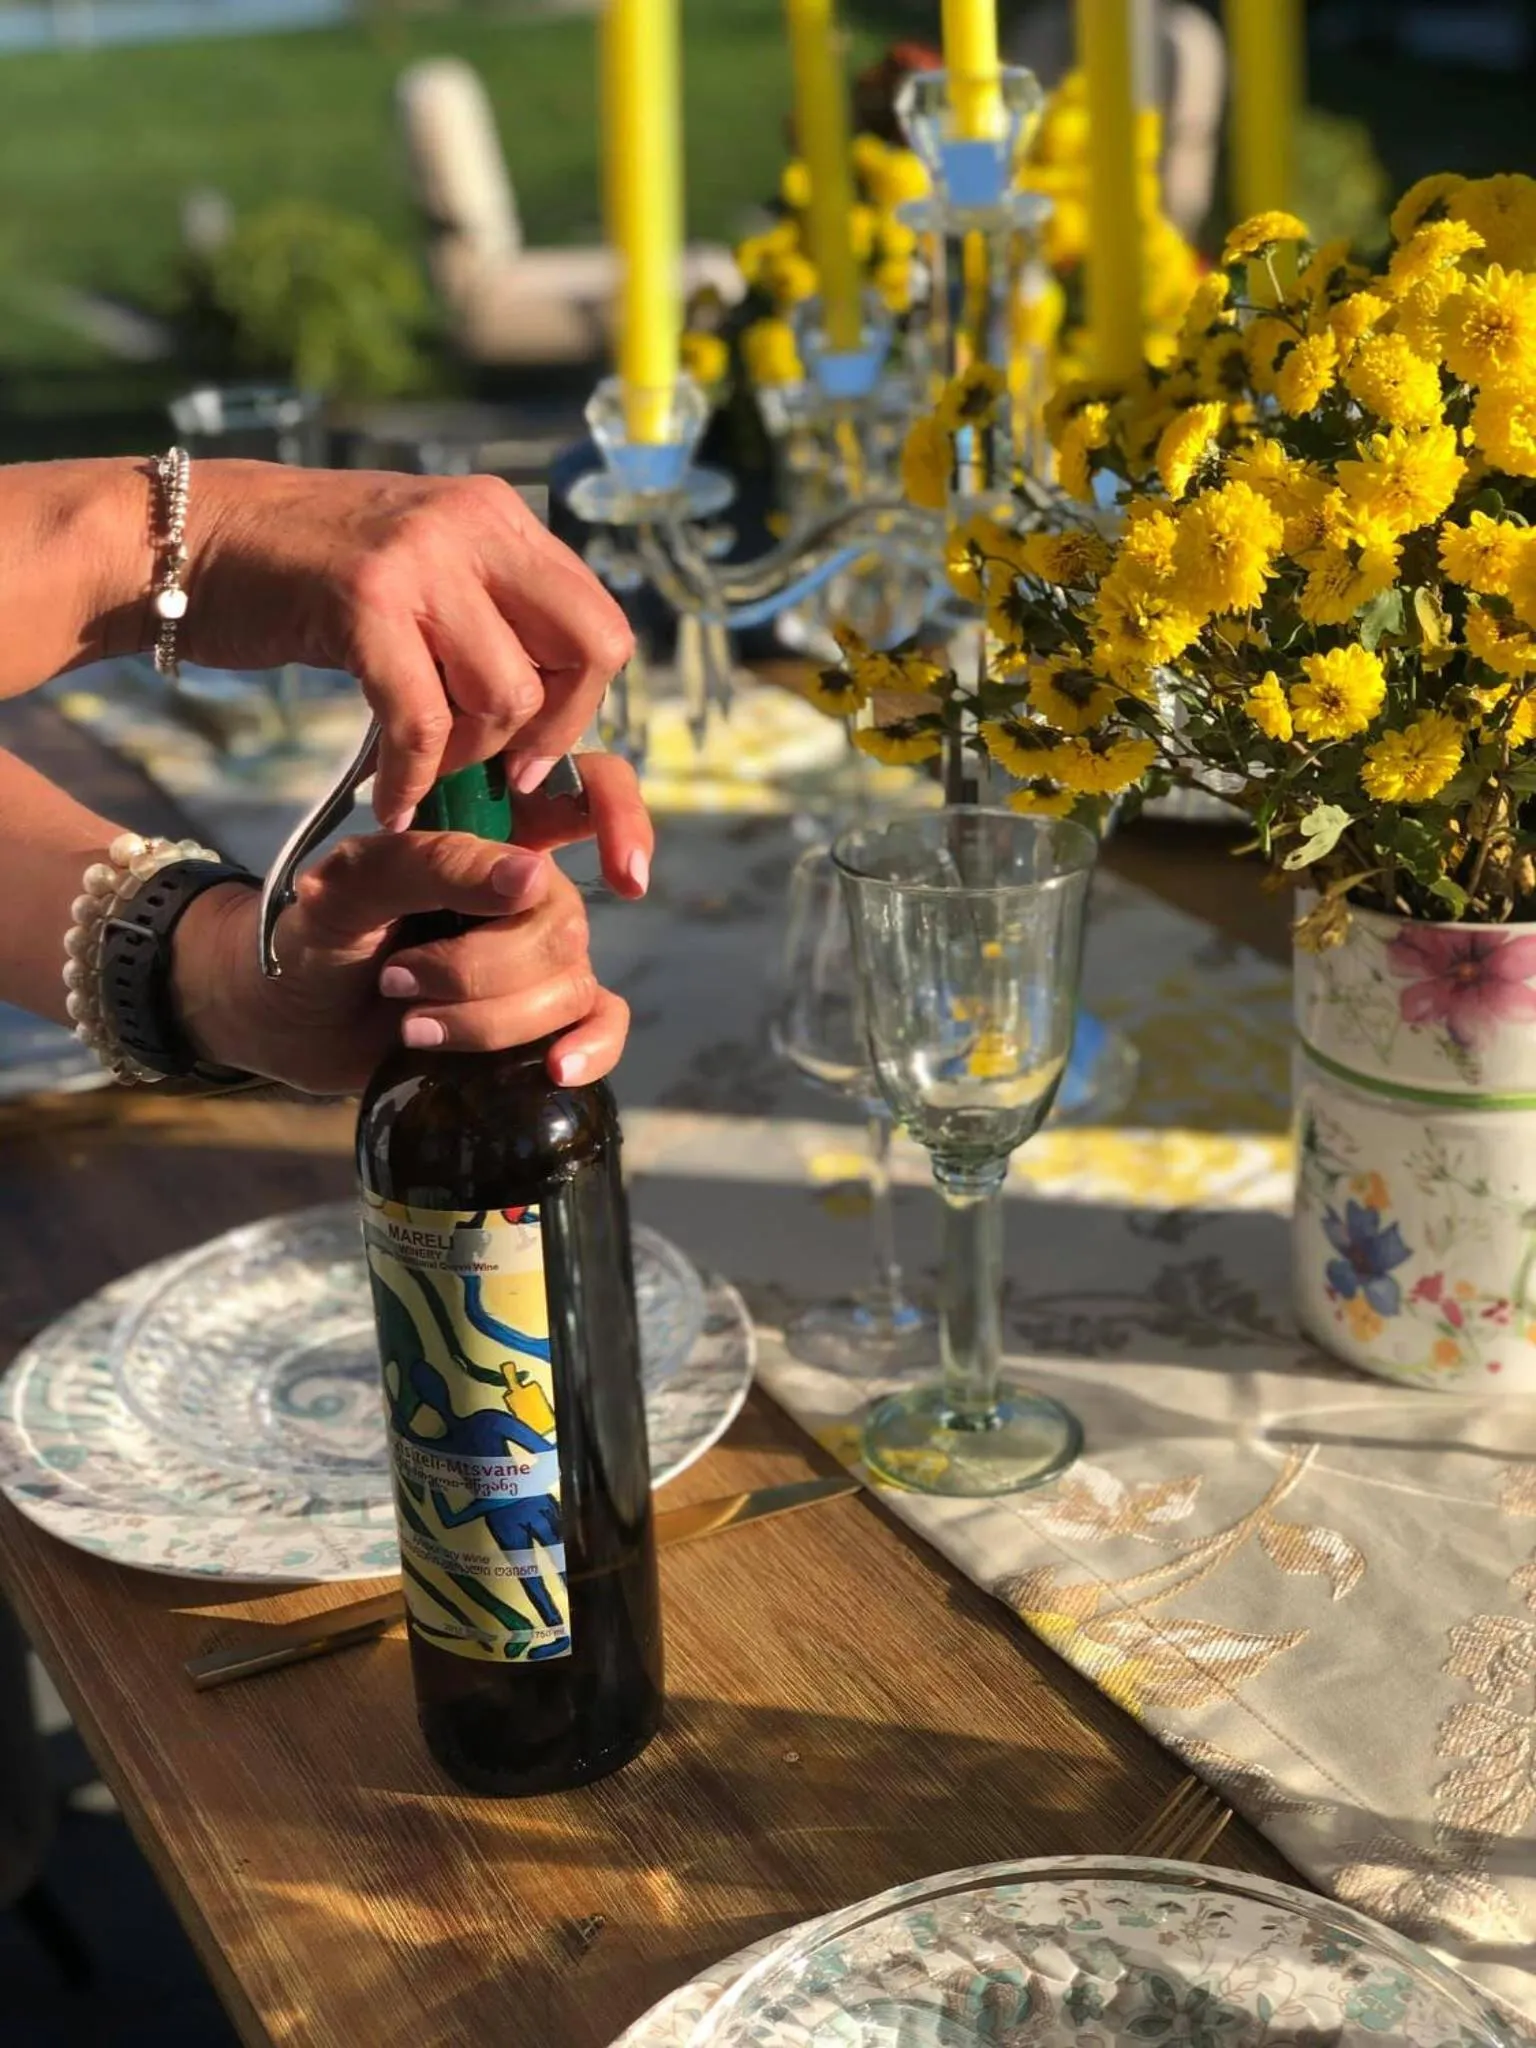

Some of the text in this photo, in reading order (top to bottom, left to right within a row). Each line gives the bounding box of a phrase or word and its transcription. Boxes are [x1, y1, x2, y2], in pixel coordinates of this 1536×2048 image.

[388, 1222, 454, 1250] MARELI
[398, 1243, 441, 1260] WINERY
[472, 1262, 499, 1272] Wine
